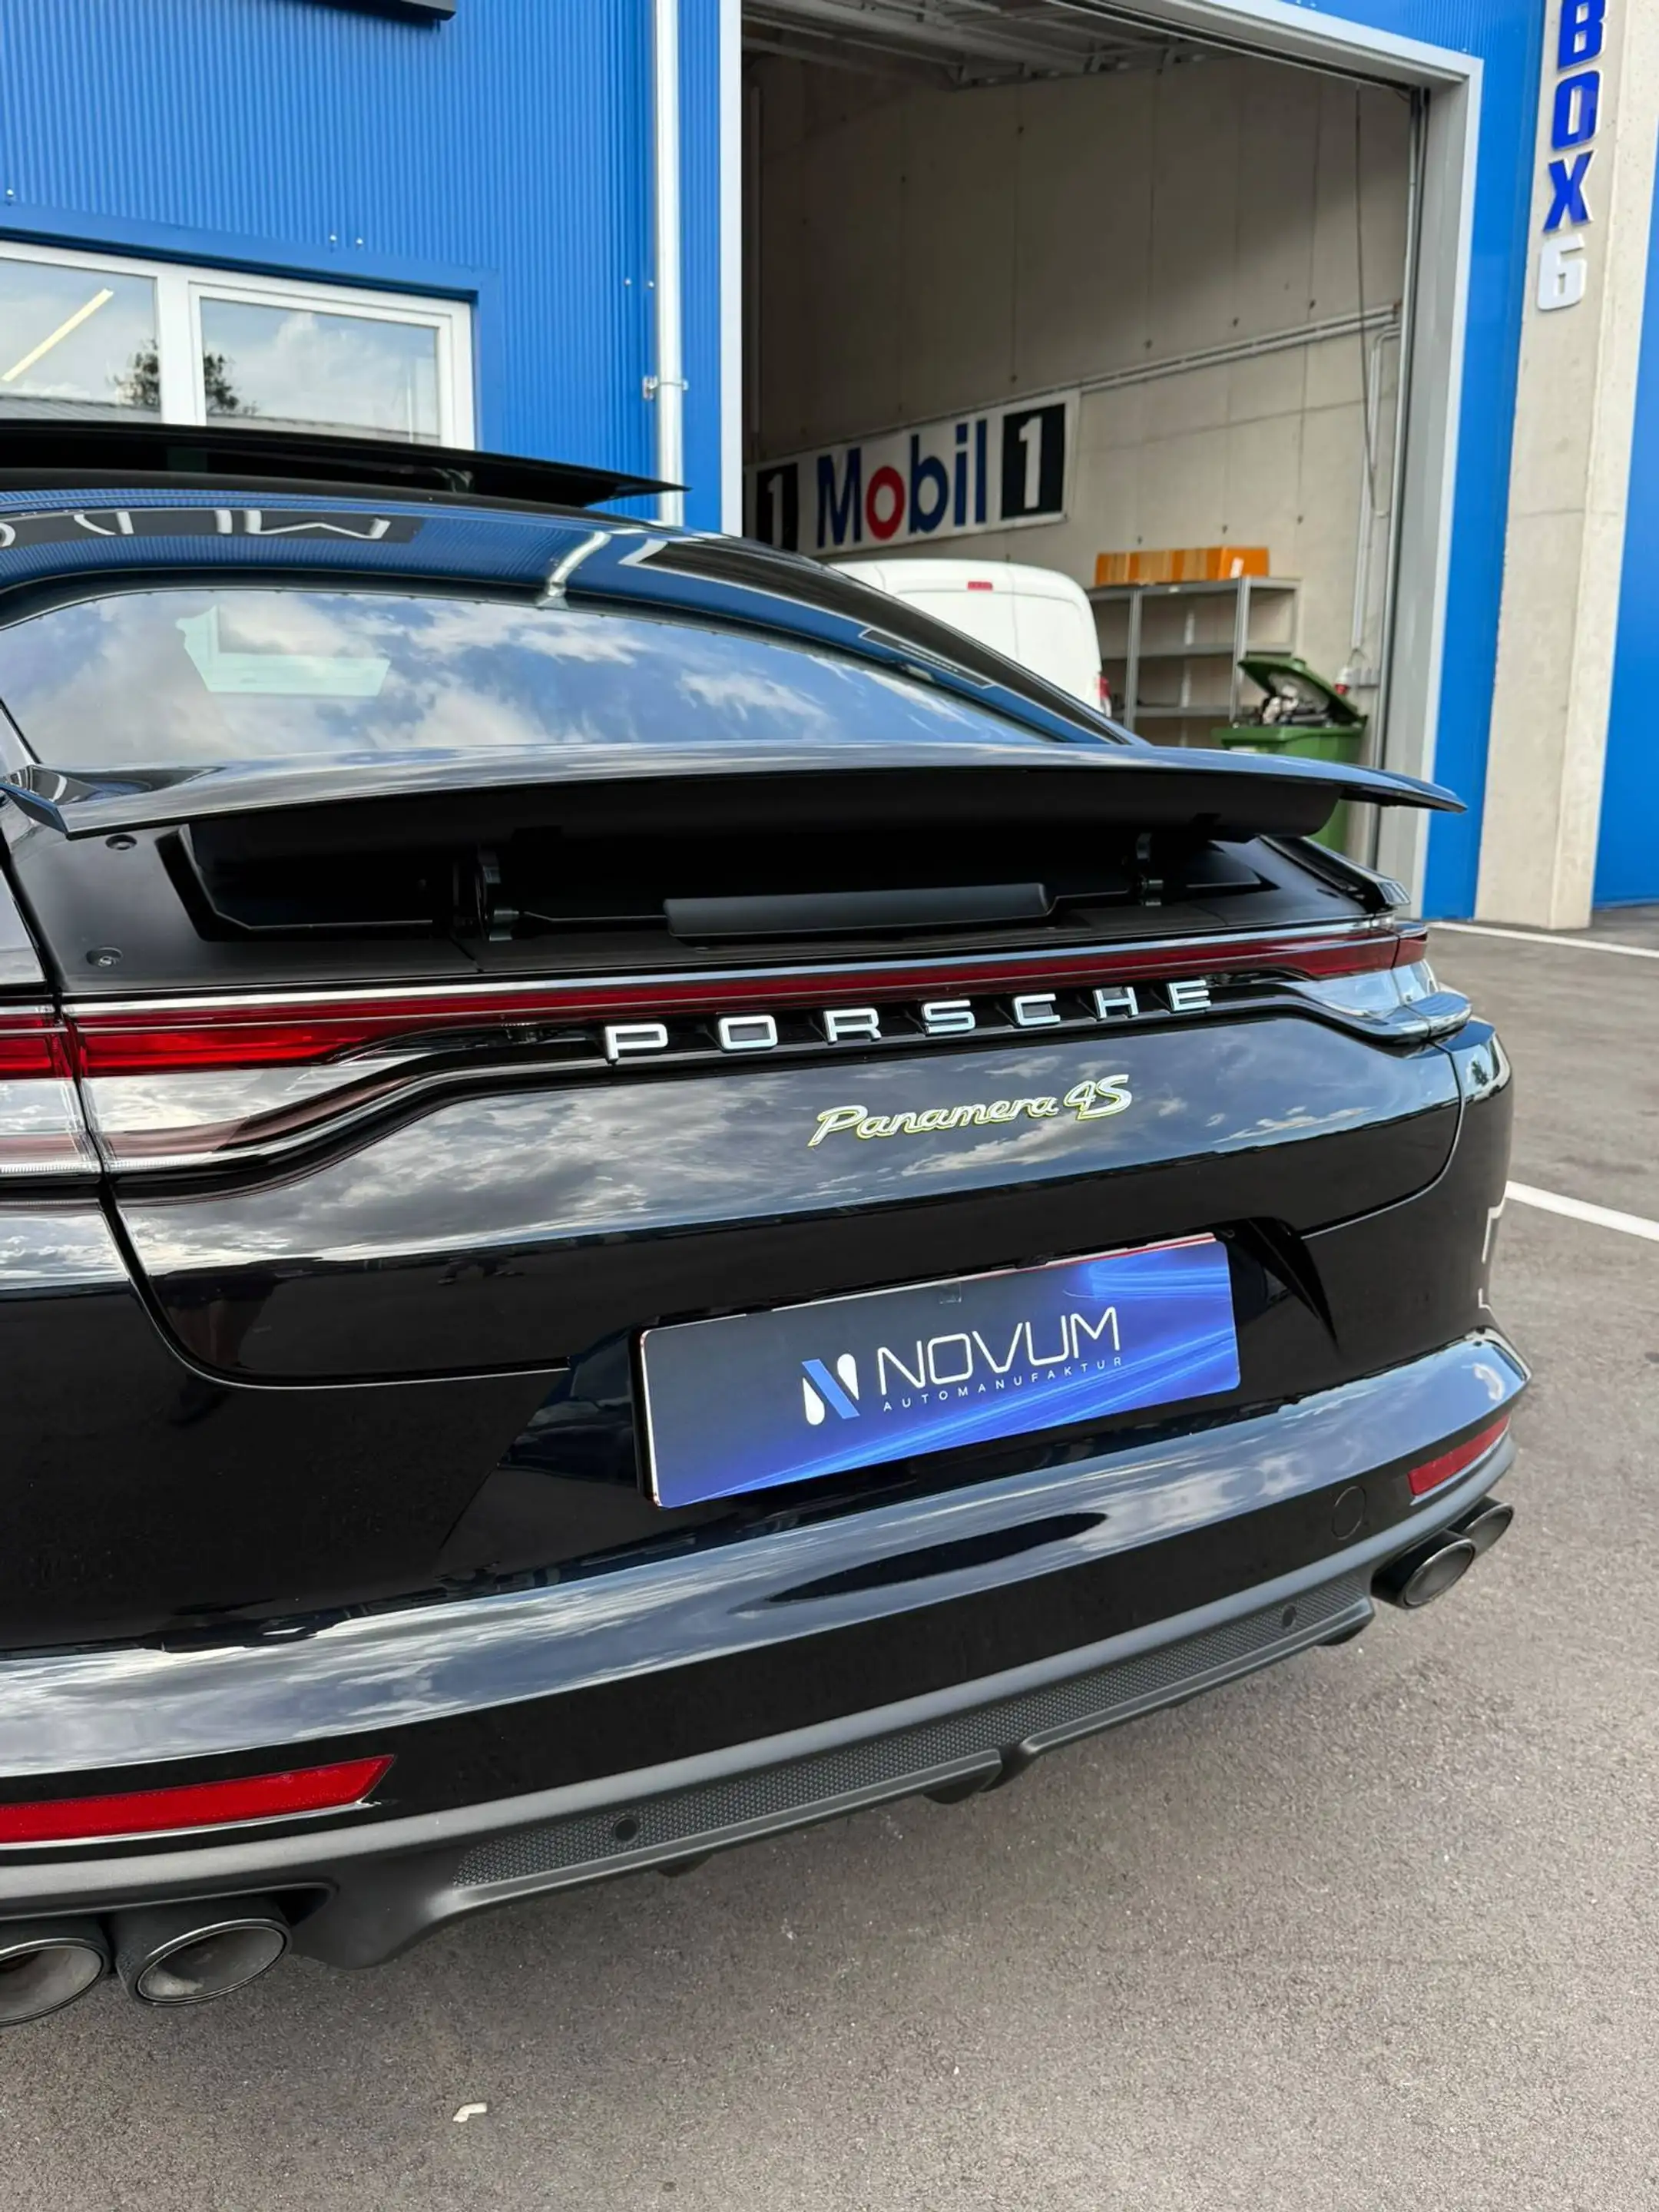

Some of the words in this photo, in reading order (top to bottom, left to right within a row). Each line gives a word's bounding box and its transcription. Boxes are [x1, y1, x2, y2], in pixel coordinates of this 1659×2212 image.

[1542, 0, 1607, 233] BOX
[1537, 233, 1588, 312] 6
[767, 472, 783, 548] 1
[816, 419, 988, 549] Mobil
[1018, 415, 1043, 510] 1
[604, 979, 1211, 1063] PORSCHE
[807, 1094, 1059, 1147] Panamera
[1064, 1074, 1133, 1121] 4S
[877, 1306, 1121, 1396] NOVUM
[882, 1356, 1123, 1412] AUTOMANUFAKTUR
